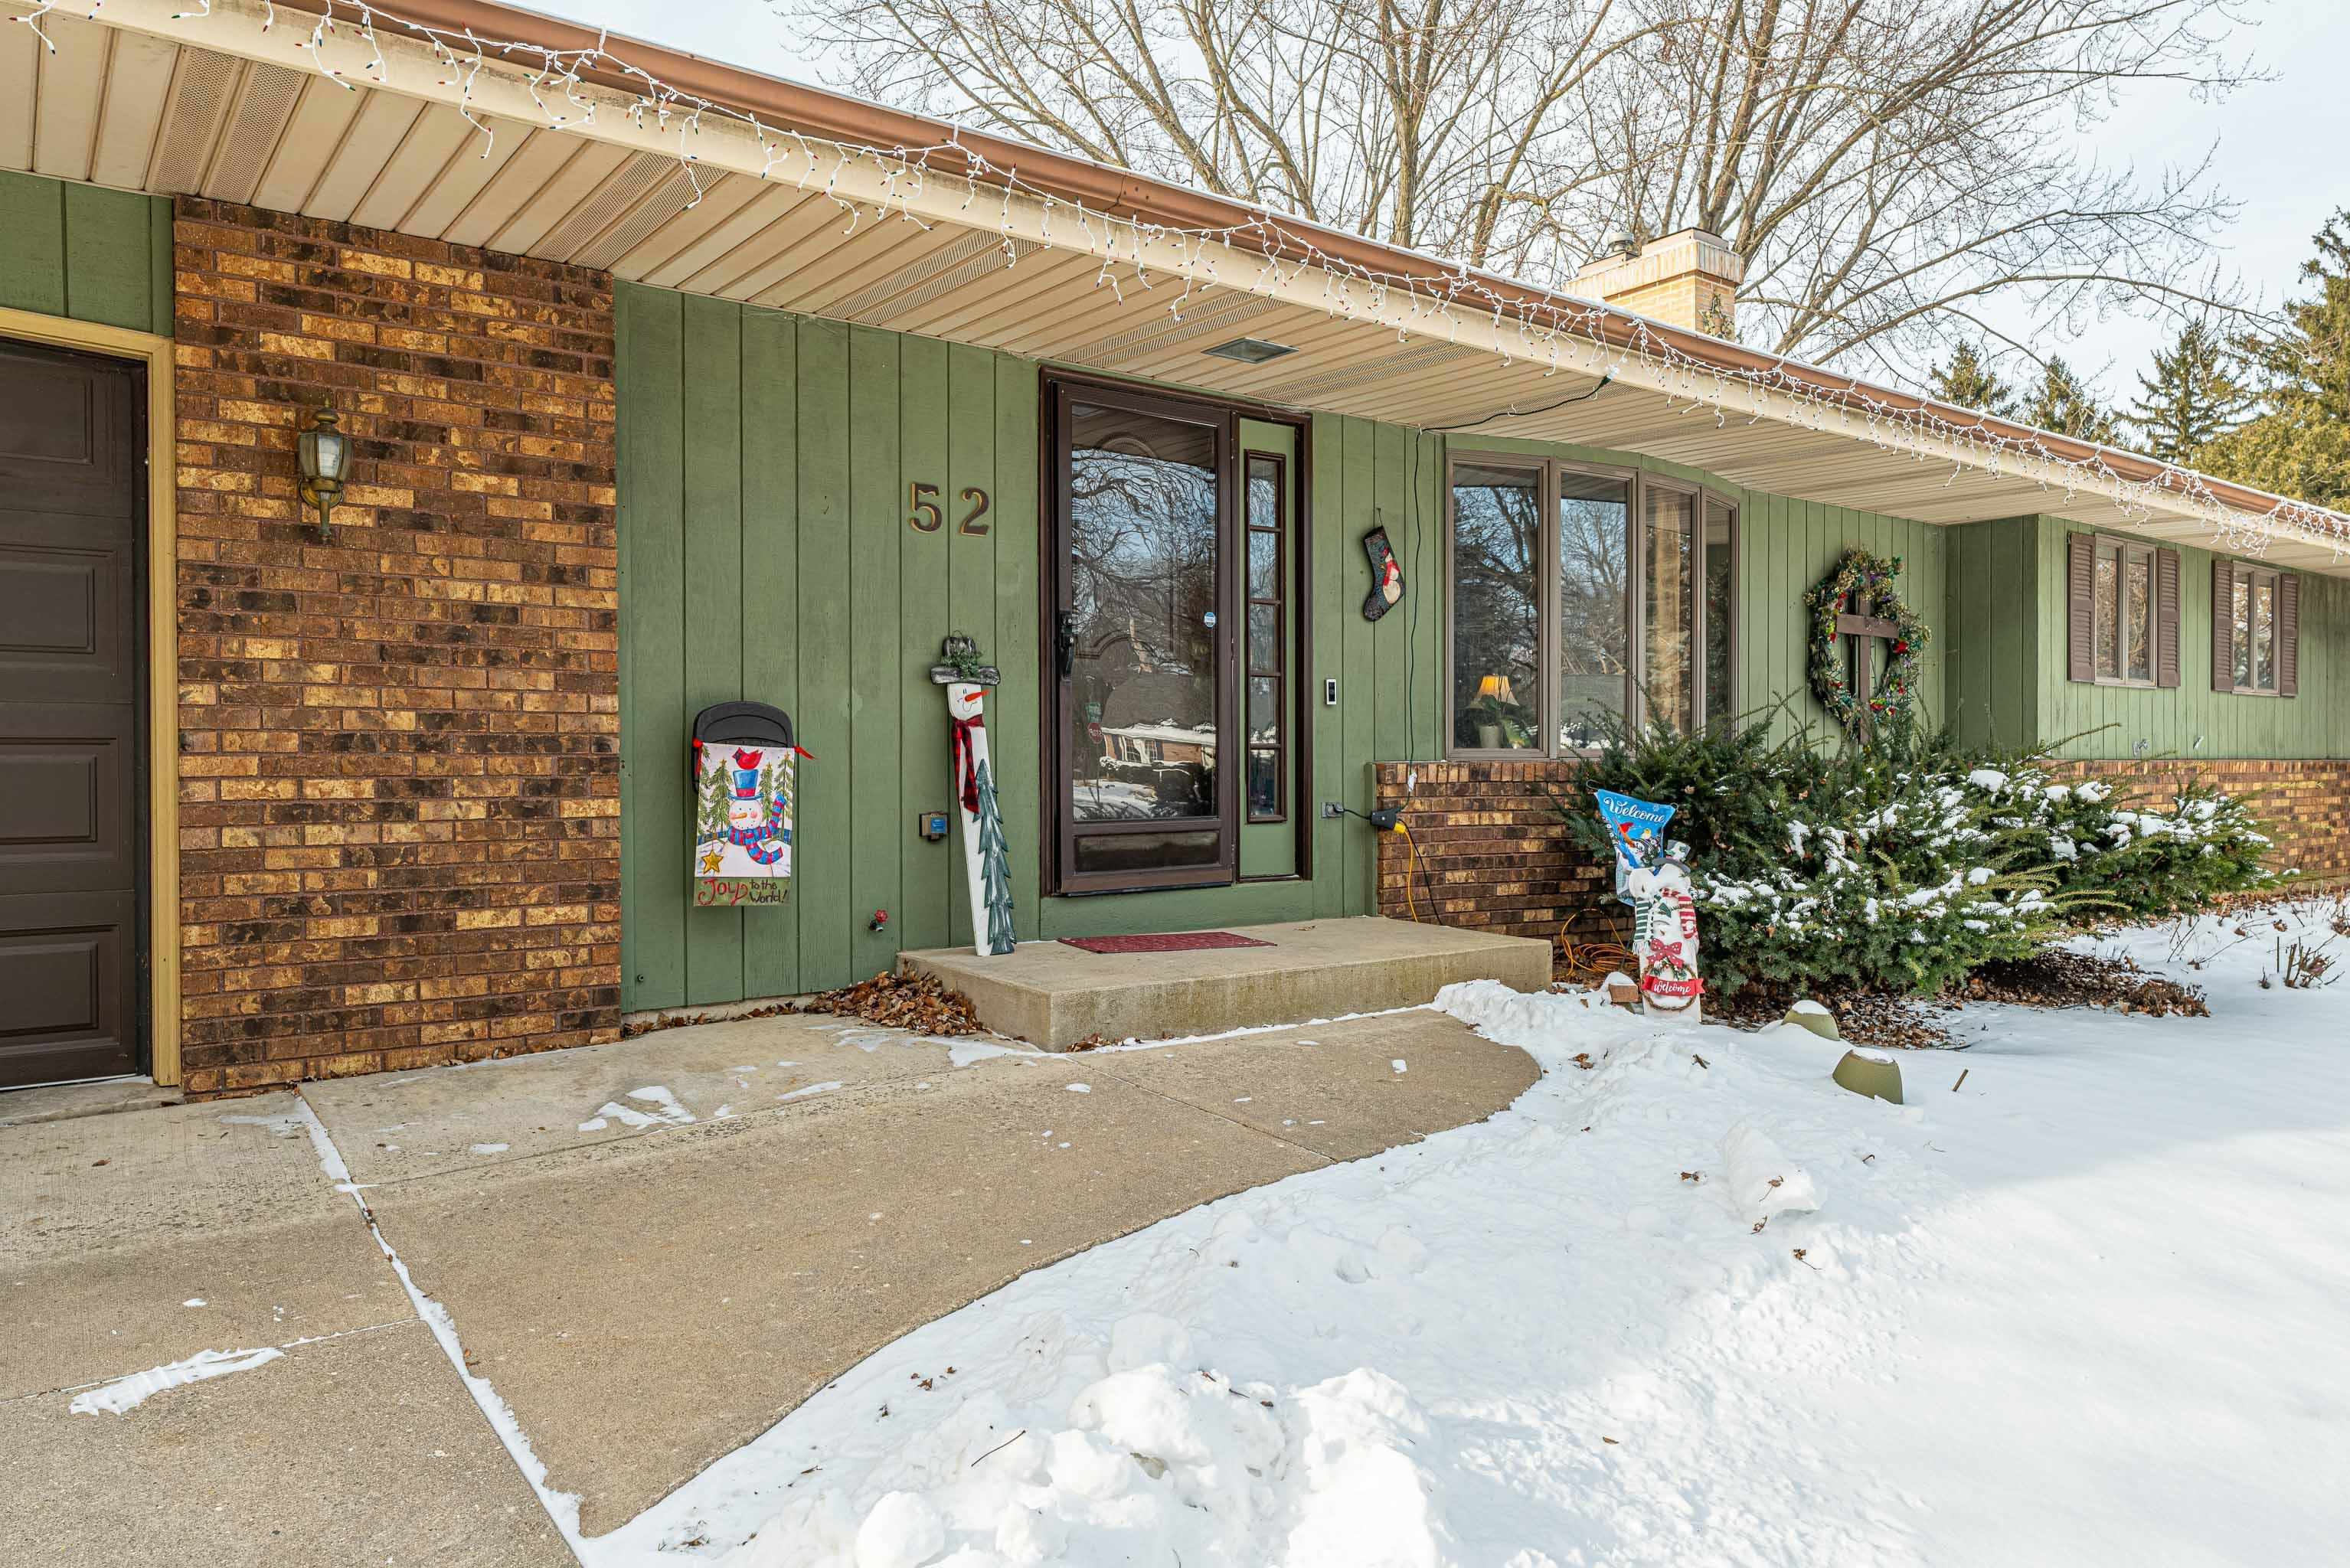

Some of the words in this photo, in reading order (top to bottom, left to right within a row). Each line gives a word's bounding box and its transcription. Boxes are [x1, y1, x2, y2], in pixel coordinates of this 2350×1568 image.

[910, 482, 989, 536] 52
[1603, 797, 1665, 823] Welcome
[698, 877, 748, 906] Joy
[761, 878, 778, 890] the
[750, 890, 787, 903] World!
[1654, 981, 1691, 995] welcome
